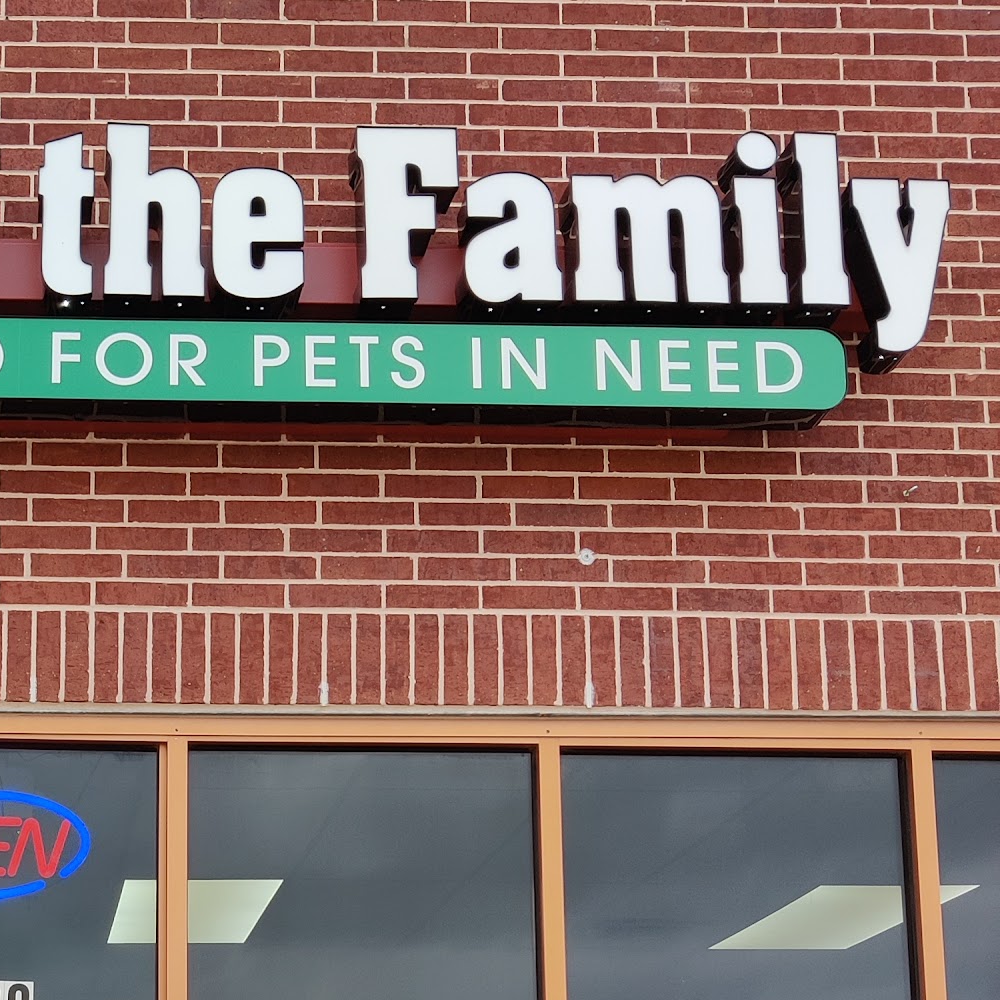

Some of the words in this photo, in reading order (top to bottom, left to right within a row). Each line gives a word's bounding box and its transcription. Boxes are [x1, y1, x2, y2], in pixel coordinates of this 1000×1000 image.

[38, 122, 305, 299] the
[355, 126, 950, 353] Family
[50, 331, 207, 387] FOR
[253, 333, 427, 390] PETS
[470, 336, 547, 391] IN
[595, 338, 804, 395] NEED
